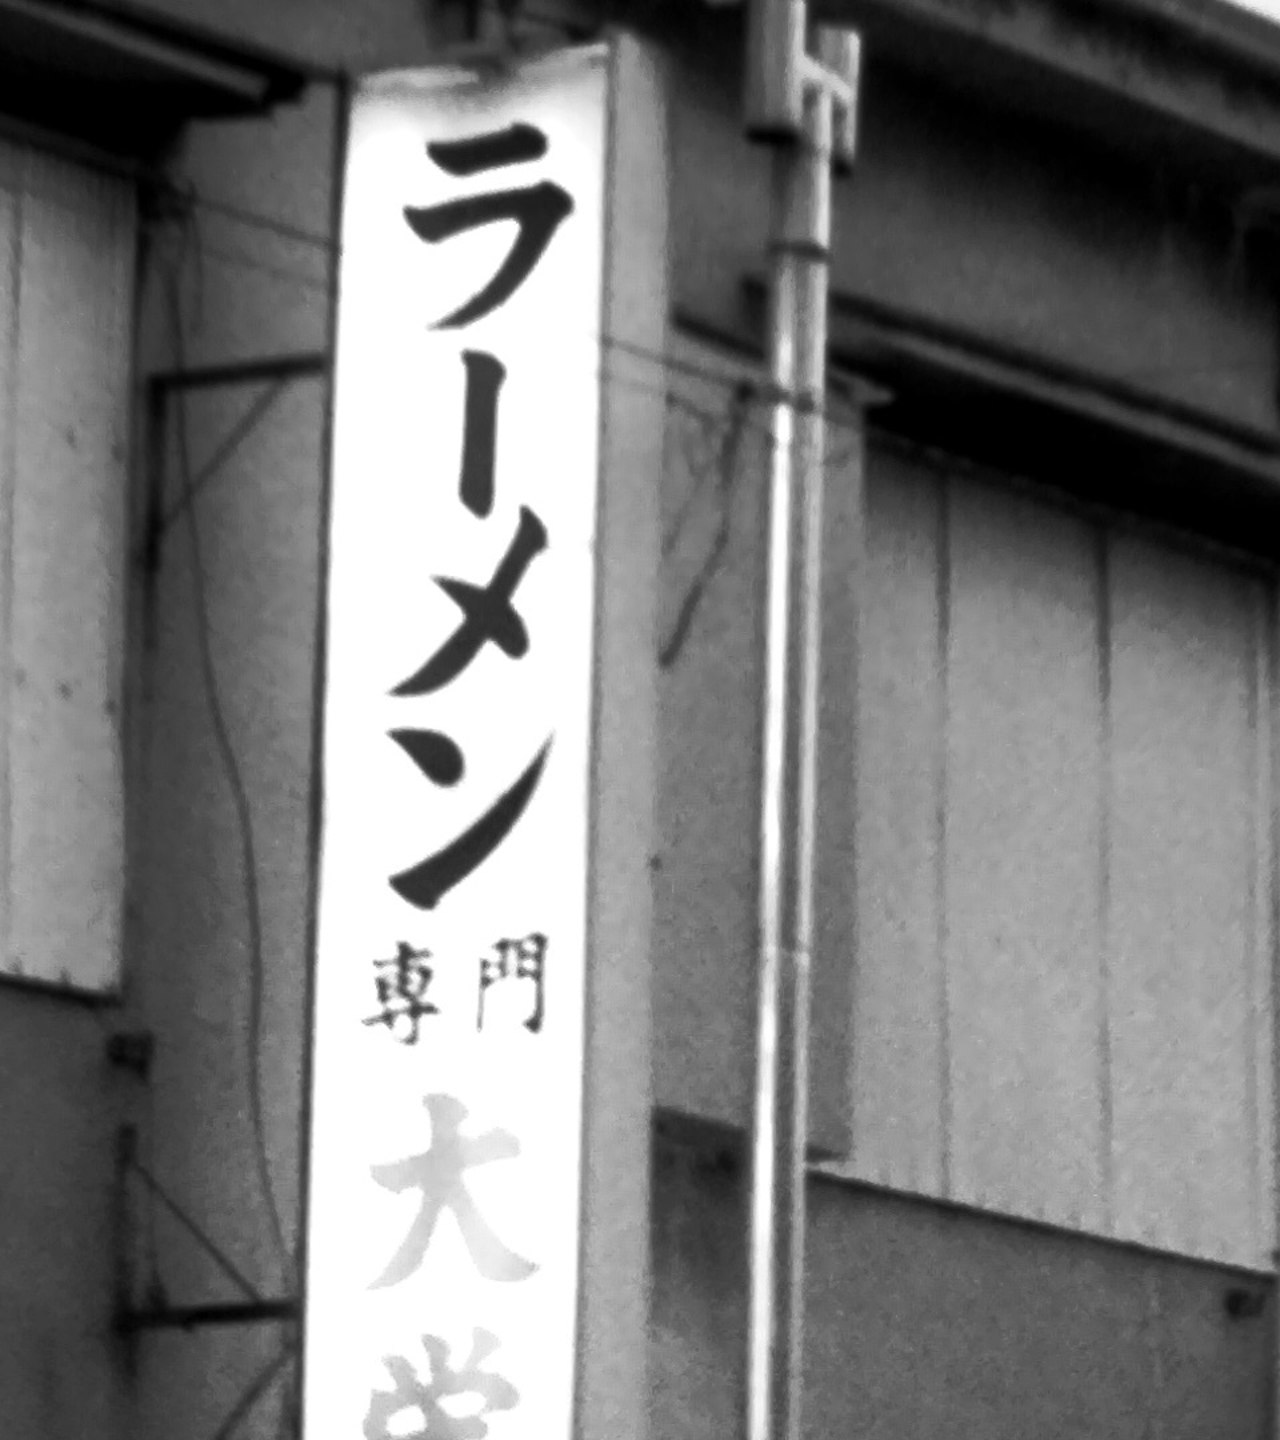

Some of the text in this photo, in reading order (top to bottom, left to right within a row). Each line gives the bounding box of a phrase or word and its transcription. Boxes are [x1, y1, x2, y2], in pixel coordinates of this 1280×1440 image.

[385, 121, 575, 911] ラーメン
[361, 932, 549, 1046] 専門
